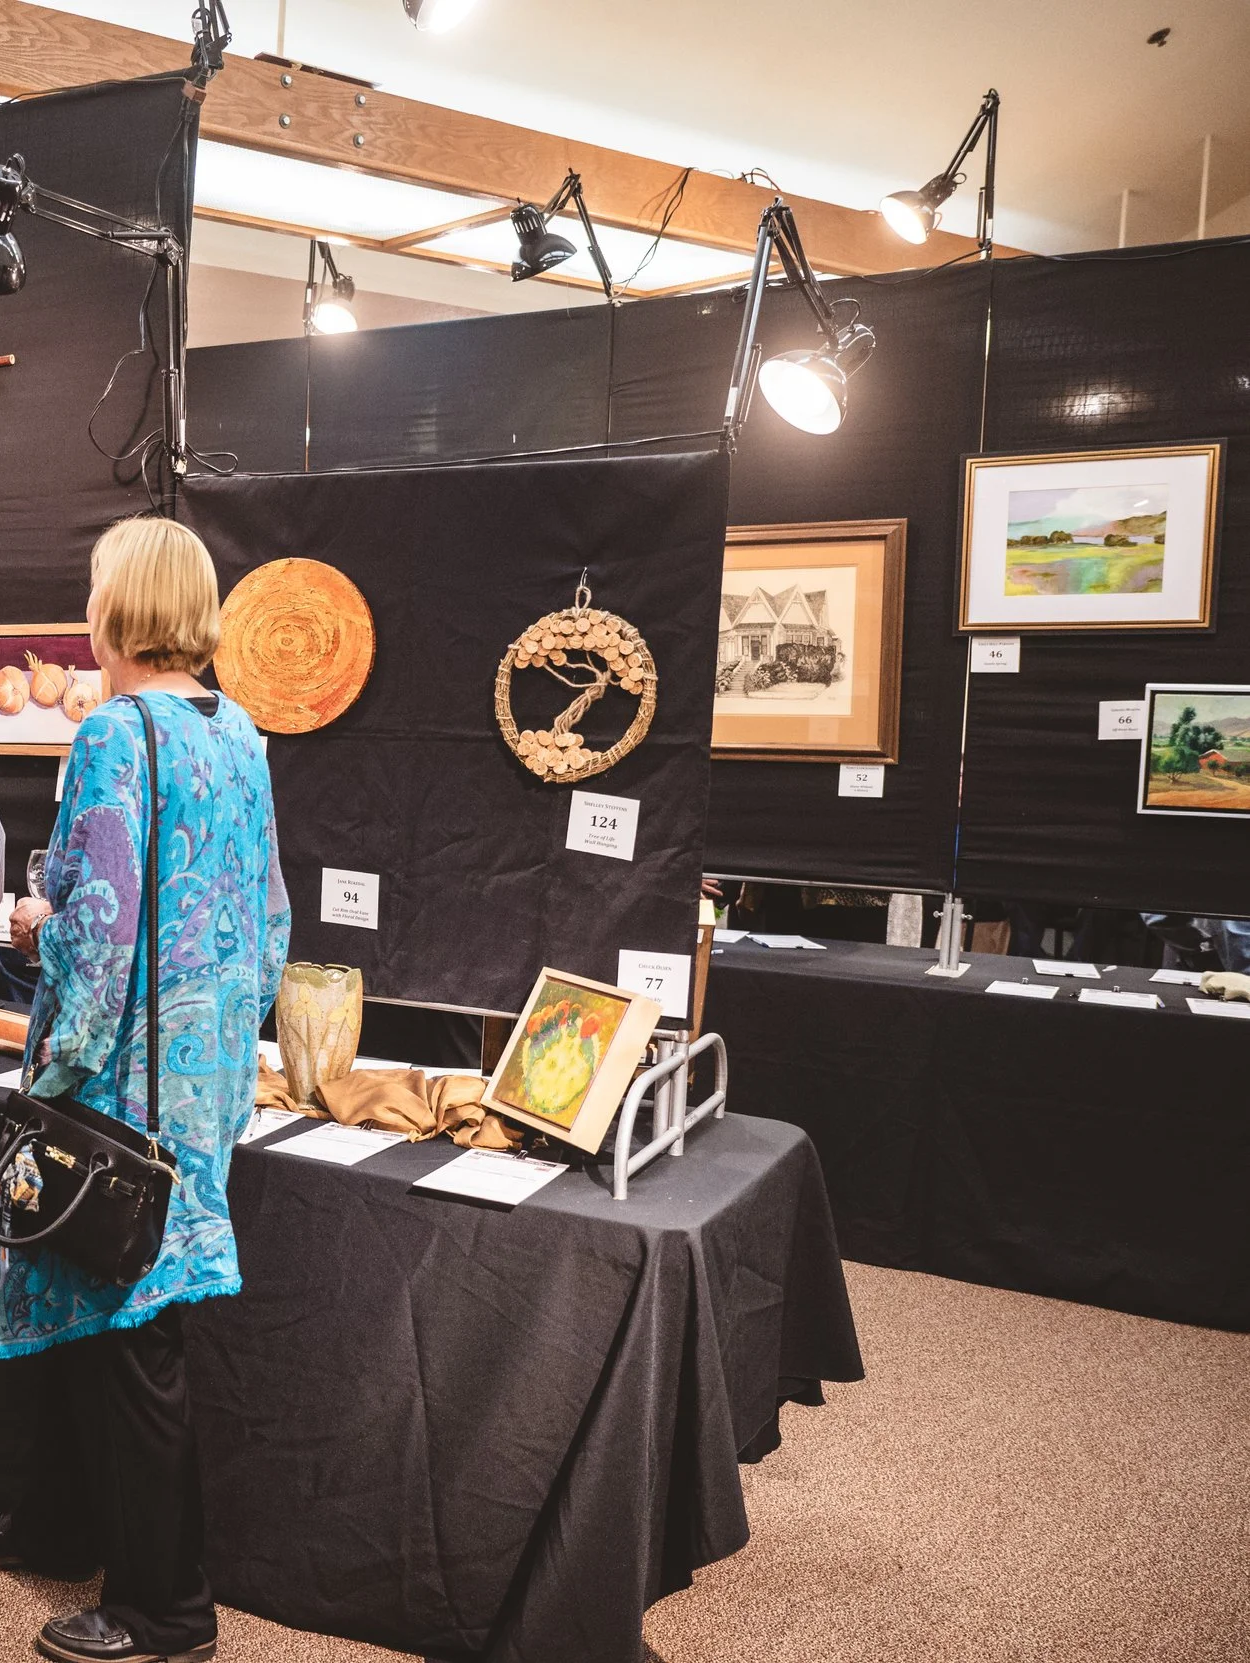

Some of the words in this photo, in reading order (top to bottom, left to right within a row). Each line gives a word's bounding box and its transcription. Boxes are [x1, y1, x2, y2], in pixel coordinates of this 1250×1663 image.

[989, 650, 1003, 658] 46
[1118, 716, 1132, 724] 66
[590, 815, 618, 830] 124
[343, 891, 359, 903] 94
[645, 977, 663, 990] 77
